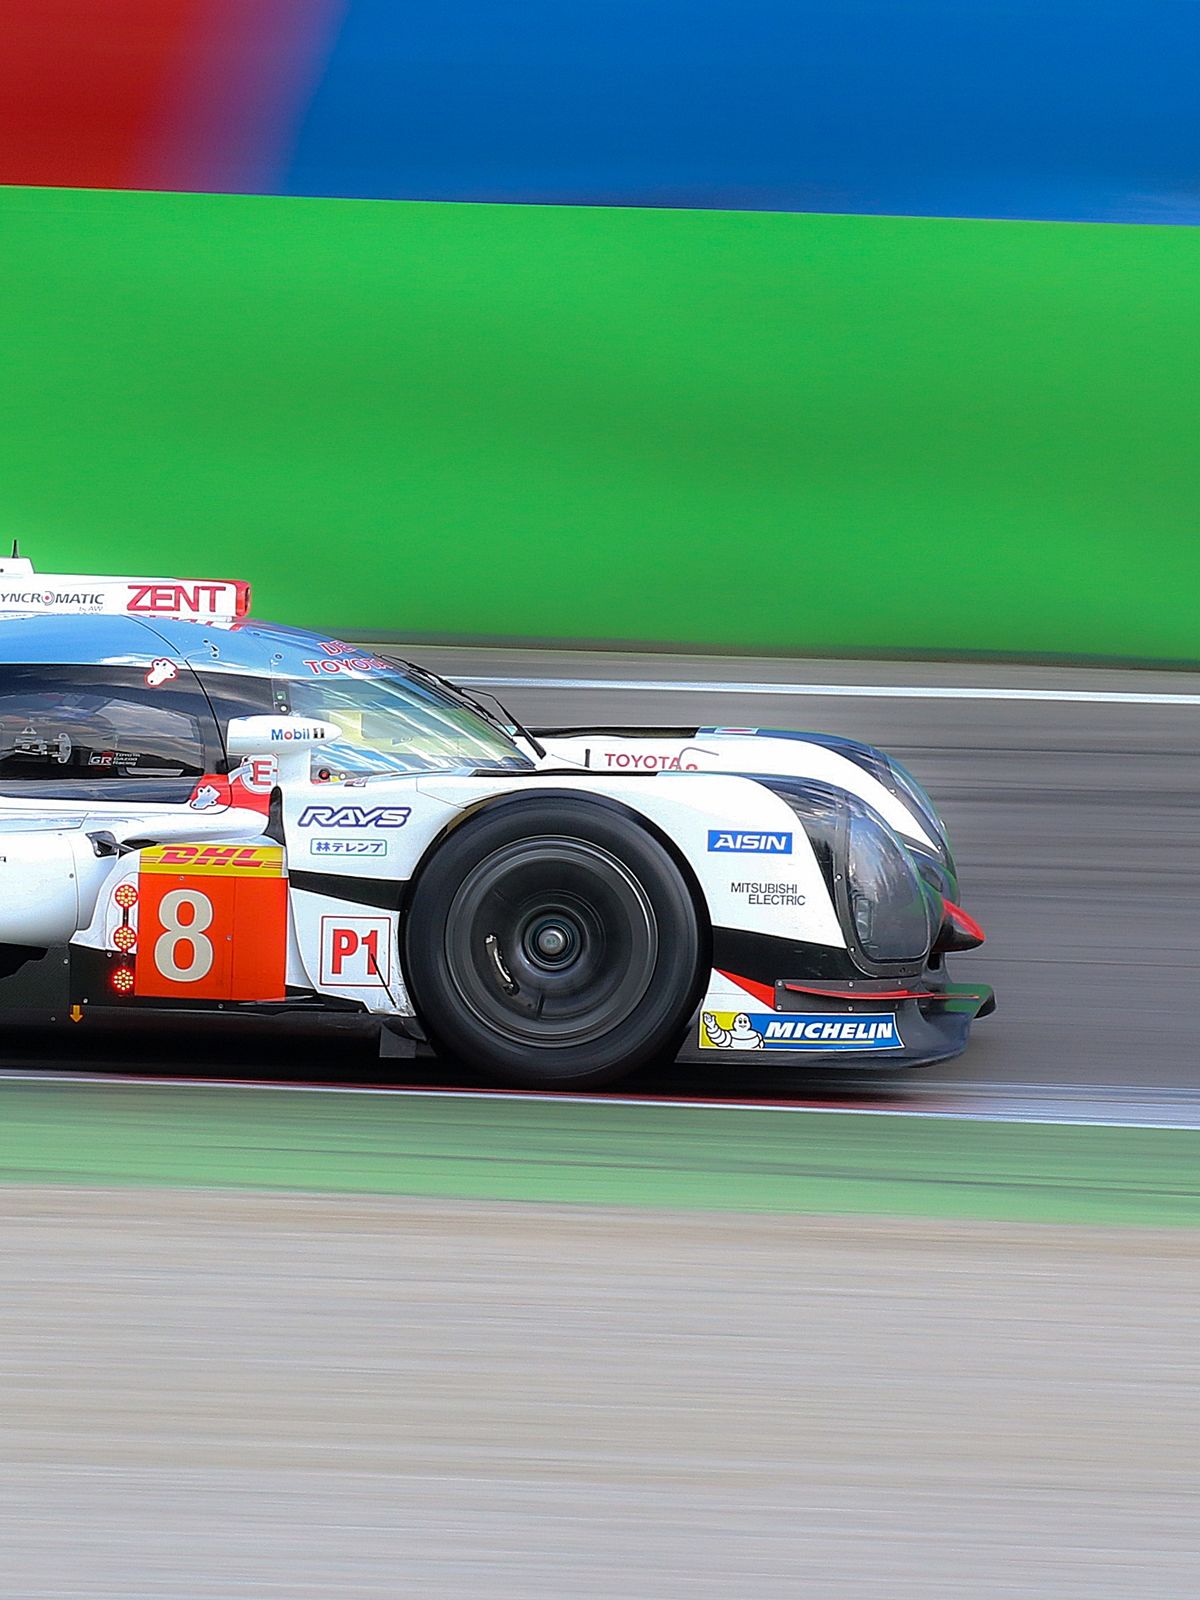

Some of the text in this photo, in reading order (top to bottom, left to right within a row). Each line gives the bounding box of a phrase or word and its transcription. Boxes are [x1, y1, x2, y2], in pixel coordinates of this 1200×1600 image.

[126, 585, 227, 613] ZENT
[271, 727, 325, 741] Mobil 1
[604, 753, 682, 771] TOYOTA
[298, 806, 412, 827] RAYS
[315, 841, 384, 853] 林テレンプ
[713, 834, 787, 850] AISIN
[158, 845, 265, 868] DHL
[730, 882, 798, 894] MITSUBISHI
[748, 894, 807, 906] ELECTRIC
[153, 888, 214, 983] 8
[331, 928, 379, 976] P1
[764, 1021, 894, 1039] MICHELIN
